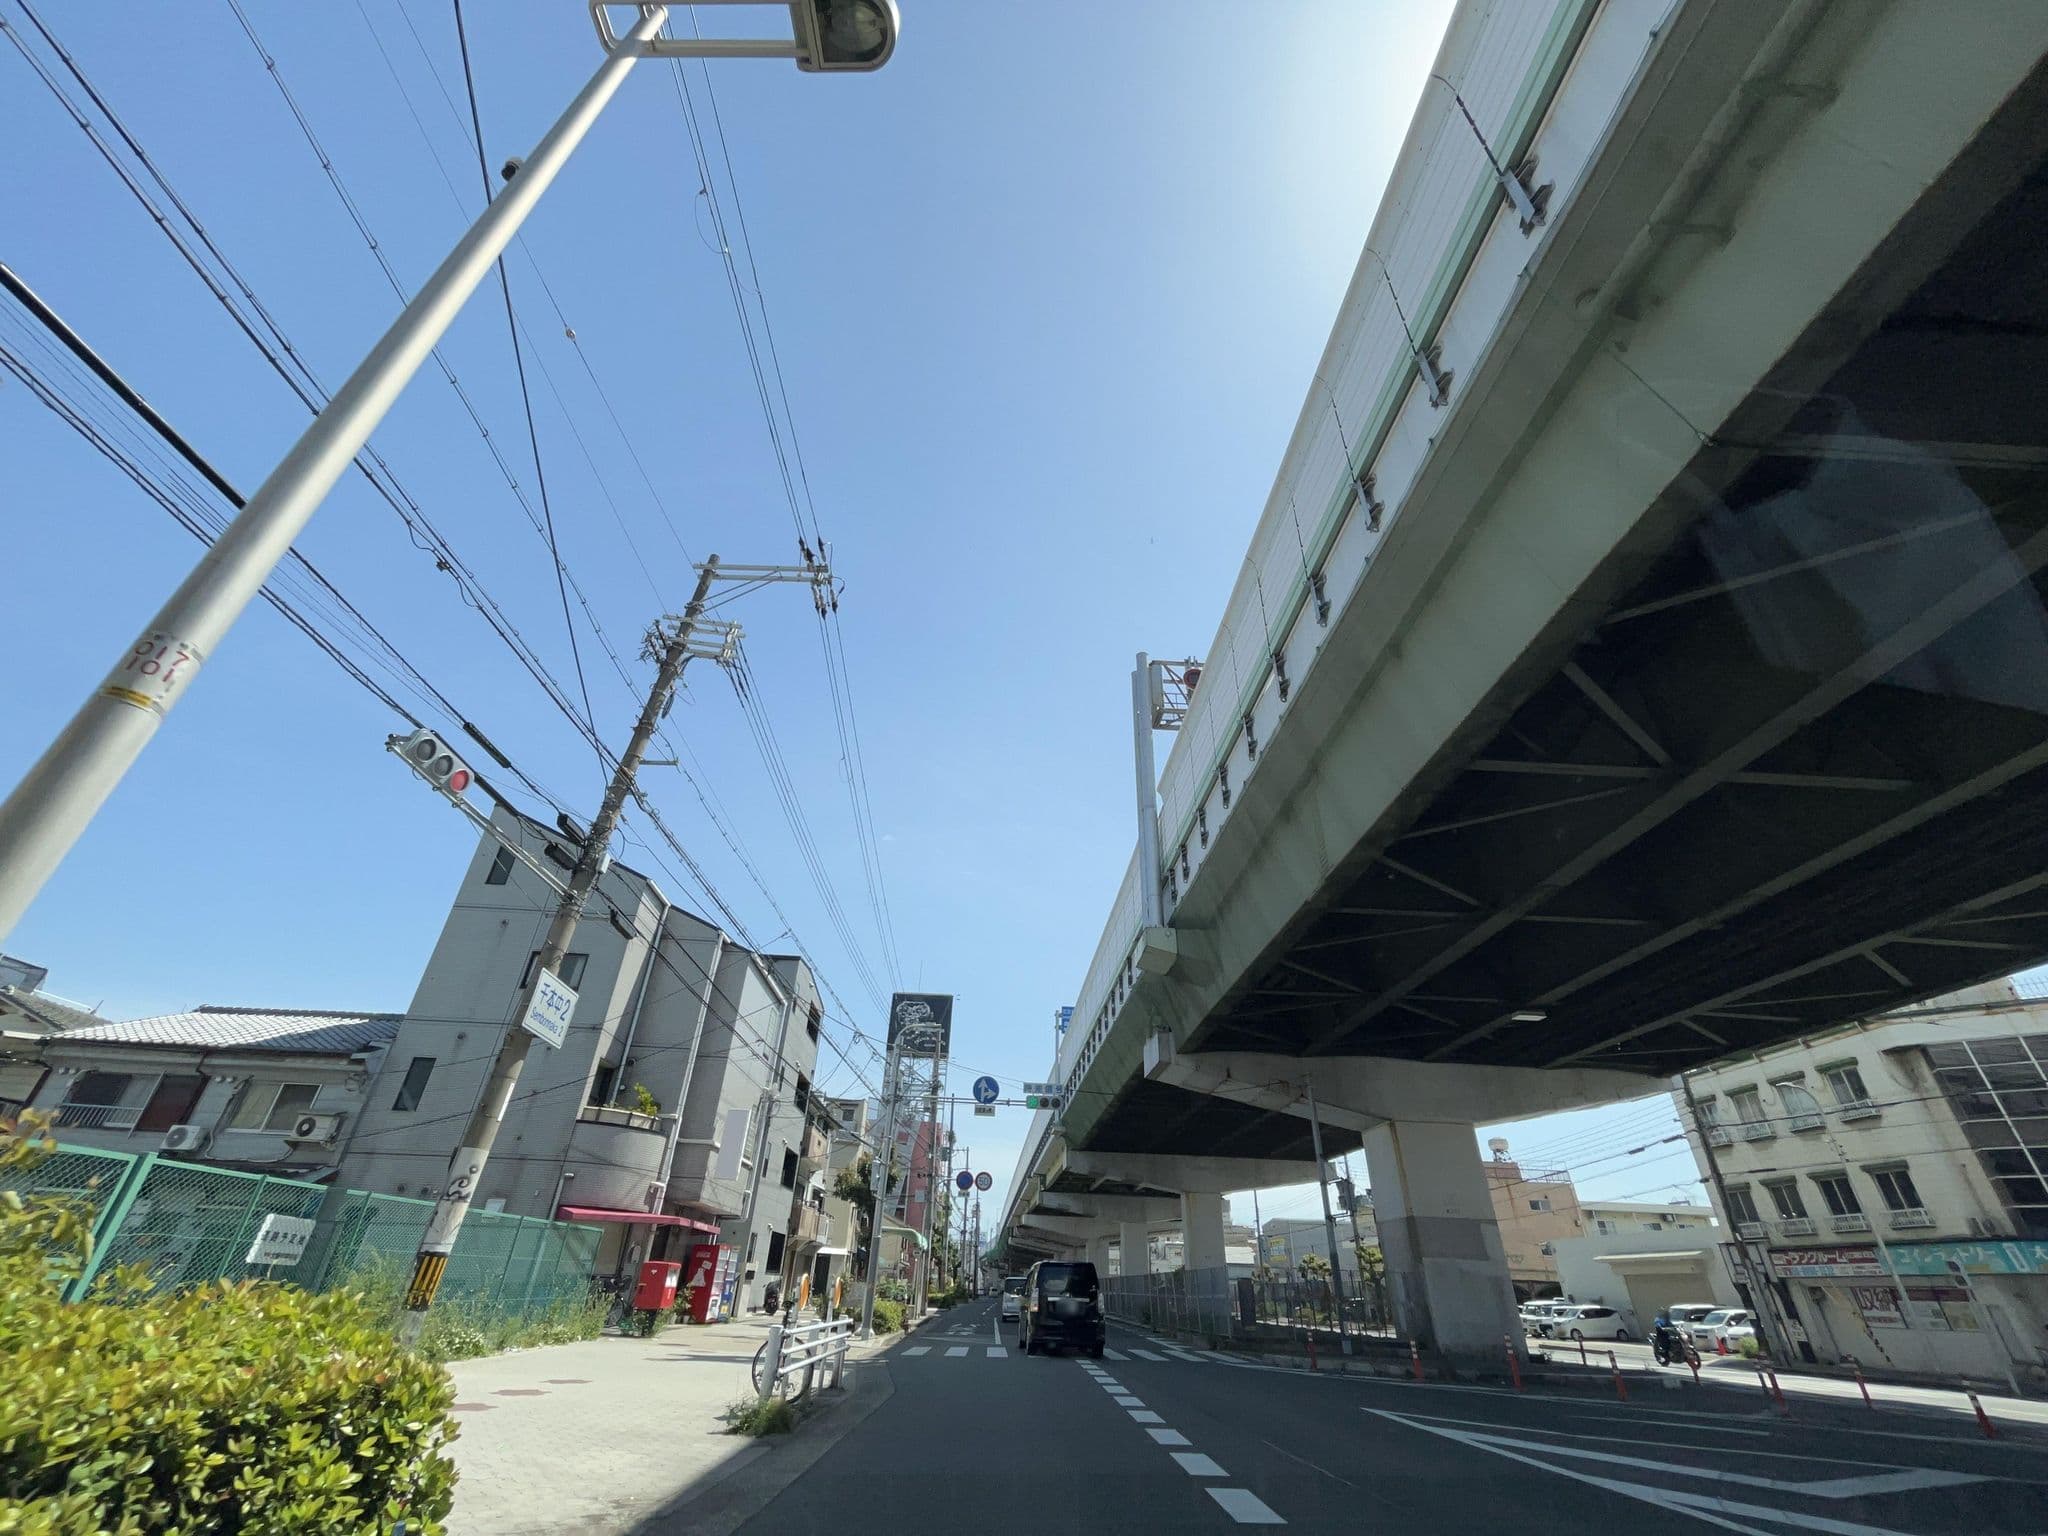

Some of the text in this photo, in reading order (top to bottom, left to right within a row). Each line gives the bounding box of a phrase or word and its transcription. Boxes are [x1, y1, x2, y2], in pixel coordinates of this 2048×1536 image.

[540, 982, 571, 1021] 千本中2
[979, 1176, 989, 1186] 50
